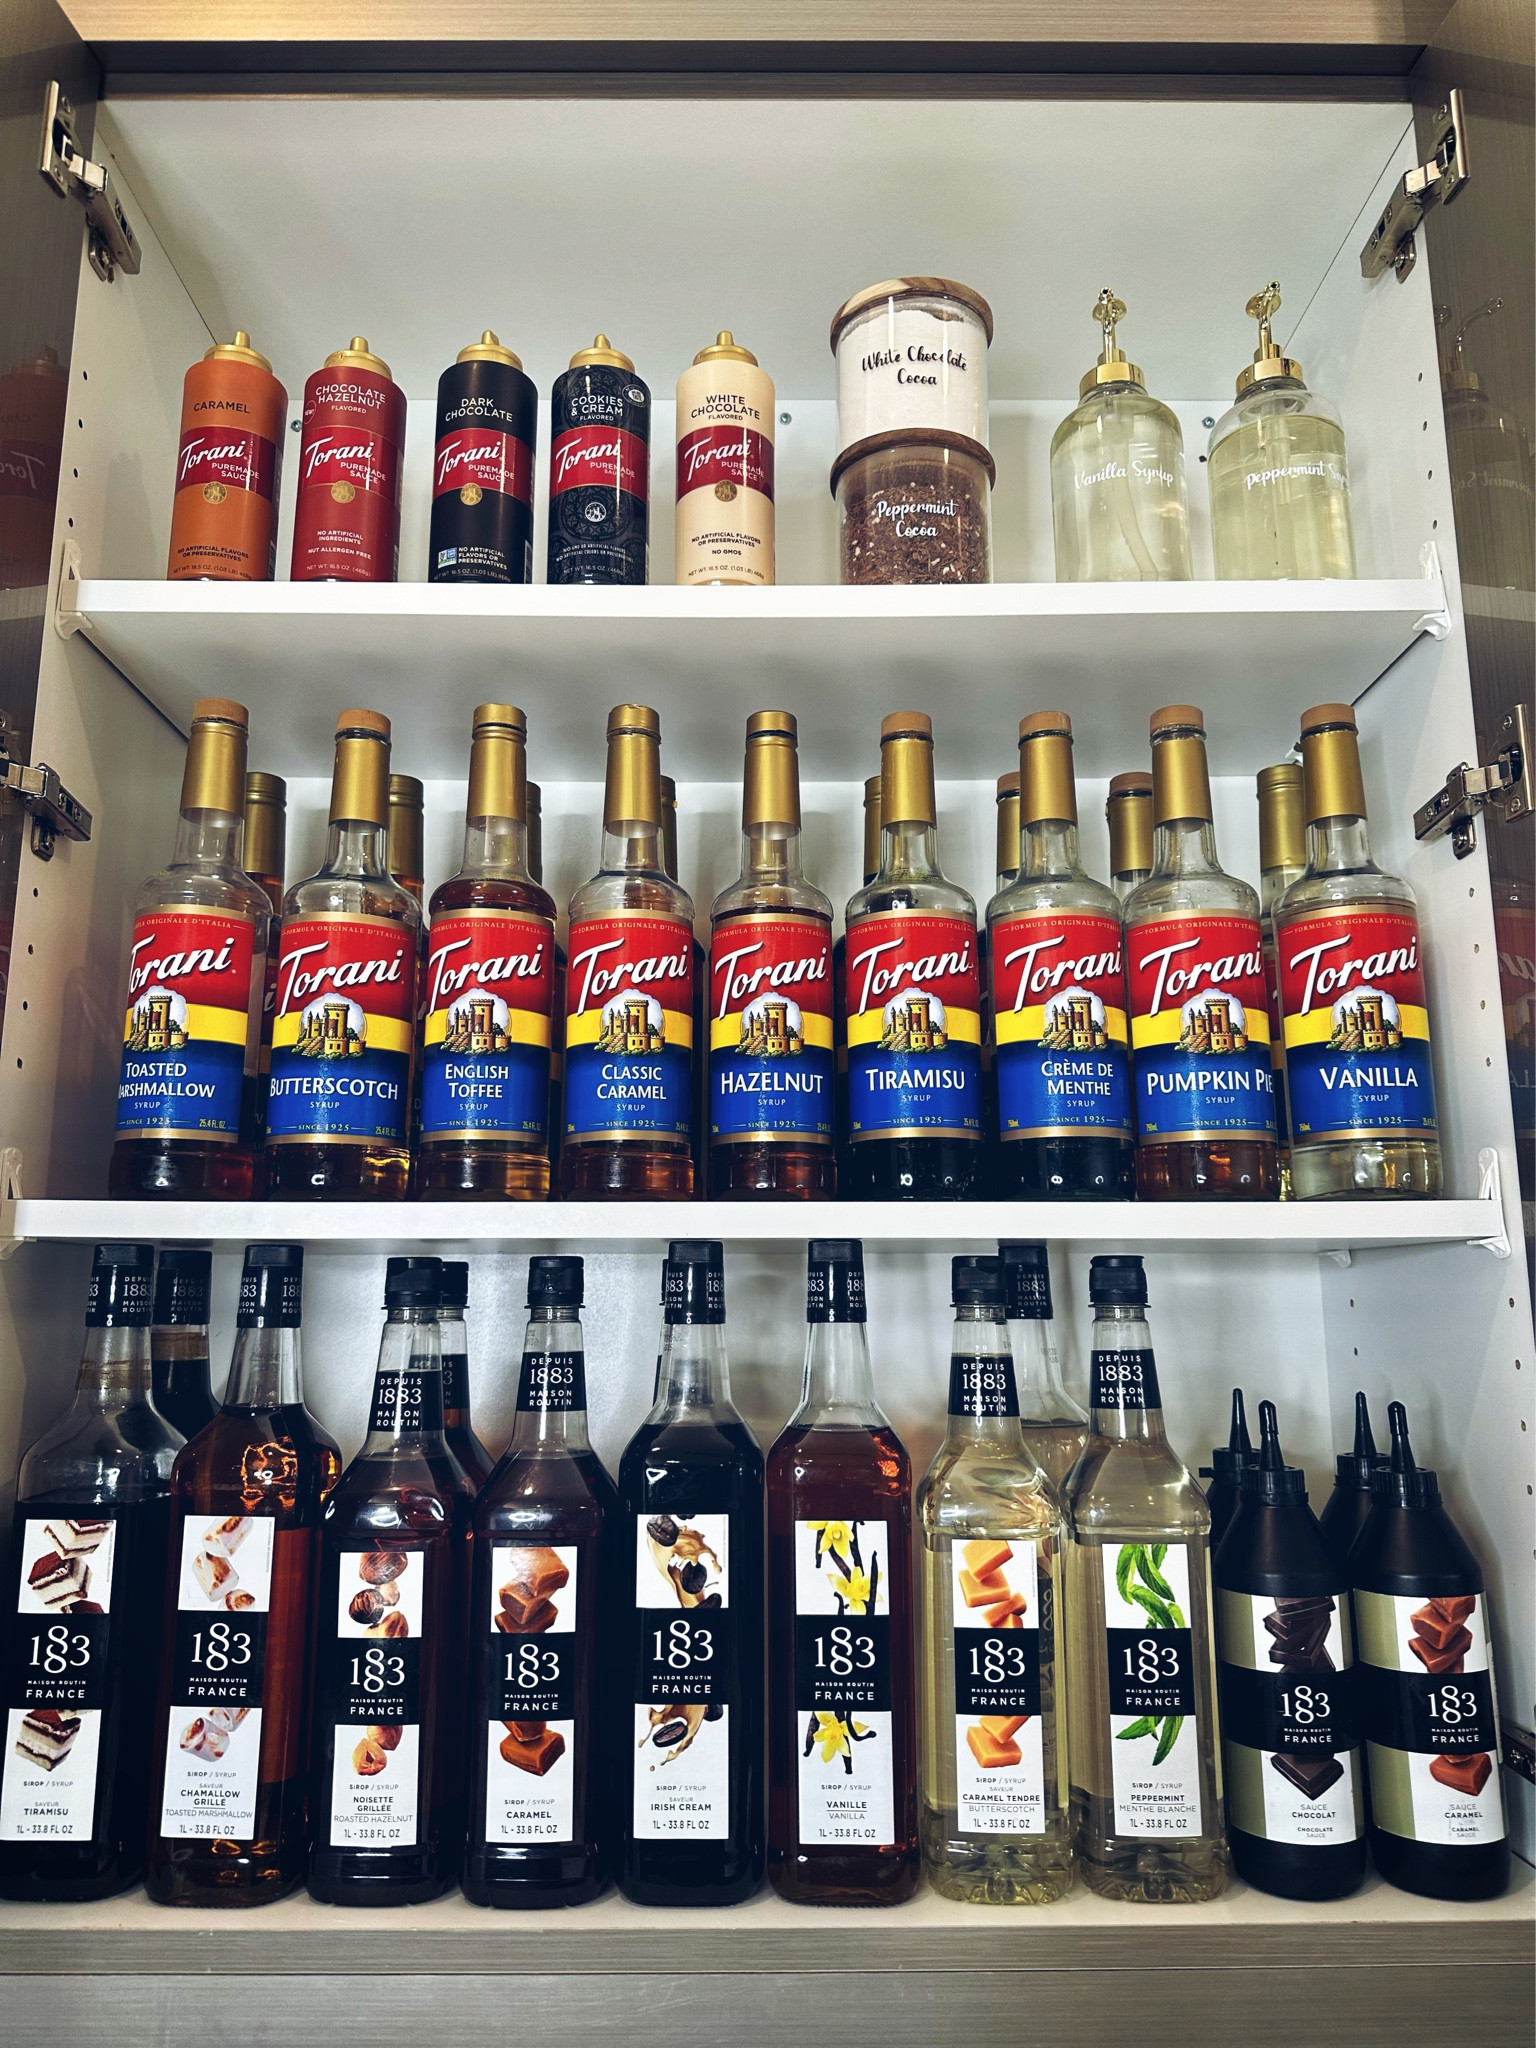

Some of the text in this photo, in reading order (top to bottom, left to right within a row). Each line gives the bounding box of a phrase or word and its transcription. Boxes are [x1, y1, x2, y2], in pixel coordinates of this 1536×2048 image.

[862, 348, 902, 372] White
[897, 367, 938, 386] Cocoa
[315, 383, 386, 404] CHOCOLATE
[318, 393, 382, 410] HAZELNUT
[461, 398, 494, 408] DARK
[571, 395, 624, 407] COOKIES
[705, 394, 746, 405] WHITE
[193, 400, 251, 414] CARAMEL
[331, 405, 367, 414] FLAVORED
[570, 404, 623, 417] & CREAM
[690, 403, 760, 421] CHOCOLATE
[445, 406, 513, 422] CHOCOLATE
[579, 414, 614, 422] FLAVORED
[180, 437, 247, 481] Torani
[305, 435, 375, 479] Torani
[555, 437, 622, 484] Torani
[684, 436, 752, 482] Torani
[438, 440, 502, 486] Torani
[1074, 459, 1174, 490] Vanilla Syrup
[1244, 461, 1327, 491] Peppermint
[875, 499, 959, 521] Peppermint
[895, 519, 938, 538] Cocoa
[318, 535, 361, 545] INGREDIENTS
[327, 530, 363, 540] ARTIFICIAL
[691, 532, 761, 545] NO ARTIFICIAL FLAVORS
[707, 537, 755, 548] PRESERVATIVES
[321, 547, 355, 556] ALLERGEN
[355, 550, 372, 560] FREE
[469, 547, 505, 558] ARTIFICIAL
[458, 558, 508, 570] PRESERVATIVES
[578, 923, 609, 934] FORMULA
[611, 921, 657, 931] ORIGINALE
[1294, 920, 1333, 934] FORMULA
[1335, 917, 1384, 927] ORIGINALE
[129, 933, 235, 994] Torani
[279, 940, 403, 1019] Torani
[428, 936, 544, 1016] Torani
[572, 937, 688, 1017] Torani
[852, 936, 971, 1016] Torani
[1004, 934, 1123, 1014] Torani
[1139, 936, 1262, 1017] Torani
[1289, 933, 1418, 1017] Torani
[714, 941, 827, 1019] Torani
[125, 1062, 188, 1079] TOASTED
[444, 1064, 509, 1081] ENGLISH
[601, 1064, 663, 1081] CLASSIC
[1040, 1058, 1114, 1078] CRÈME DE
[720, 1071, 824, 1095] HAZELNUT
[865, 1068, 966, 1091] TIRAMISU
[1146, 1068, 1274, 1096] PUMPKIN PIE
[1319, 1066, 1419, 1090] VANILLA
[269, 1077, 399, 1101] BUTTERSCOTCH
[448, 1082, 503, 1099] TOFFEE
[596, 1083, 667, 1101] CARAMEL
[1047, 1079, 1111, 1096] MENTHE
[757, 1098, 787, 1107] SYRUP
[901, 1093, 932, 1102] SYRUP
[1205, 1095, 1235, 1104] SYRUP
[1358, 1094, 1390, 1103] SYRUP
[134, 1101, 161, 1110] SYRUP
[309, 1101, 340, 1110] SYRUP
[459, 1102, 489, 1111] SYRUP
[616, 1103, 646, 1112] SYRUP
[1066, 1099, 1096, 1108] SYRUP
[605, 1118, 656, 1128] SINCE 1925
[892, 1115, 943, 1125] SINCE 1925
[1348, 1115, 1402, 1126] SINCE 1925
[531, 1357, 573, 1365] DEPUIS
[1098, 1355, 1142, 1363] DEPUIS
[529, 1367, 574, 1384] 1883
[1099, 1365, 1144, 1382] 1883
[962, 1373, 1006, 1390] 1883
[378, 1388, 423, 1404] 1883
[1100, 1387, 1144, 1395] MAISON
[1101, 1396, 1144, 1404] ROUTIN
[26, 1689, 86, 1699] FRANCE
[188, 1686, 248, 1697] FRANCE
[652, 1684, 712, 1694] FRANCE
[814, 1691, 875, 1700] FRANCE
[971, 1696, 1026, 1706] FRANCE
[1126, 1696, 1181, 1706] FRANCE
[350, 1706, 404, 1716] FRANCE
[504, 1701, 559, 1711] FRANCE
[1284, 1734, 1333, 1743] FRANCE
[1432, 1734, 1480, 1743] FRANCE
[180, 1789, 240, 1798] CHAMALLOW
[962, 1793, 1040, 1802] CARAMEL TENDRE
[1131, 1794, 1185, 1802] PEPPERMINT
[193, 1797, 226, 1807] GRILLÉ
[353, 1796, 394, 1804] NOISETTE
[826, 1800, 868, 1809] VANILLE
[23, 1808, 69, 1816] TIRAMISU
[357, 1803, 392, 1812] GRILLÉE
[650, 1803, 712, 1811] IRISH CREAM
[968, 1804, 1035, 1813] BUTTERSCOTCH
[1119, 1804, 1197, 1813] MENTHE BLANCHE
[1300, 1803, 1328, 1811] SAUCE
[165, 1809, 253, 1818] TOASTED MARSHMALLOW
[334, 1814, 413, 1823] ROASTED HAZELNUT
[506, 1811, 552, 1819] CARAMEL
[828, 1812, 866, 1820] VANILLA
[1292, 1811, 1336, 1819] CHOCOLAT
[179, 1824, 235, 1835] 1L 33.8 FL OZ
